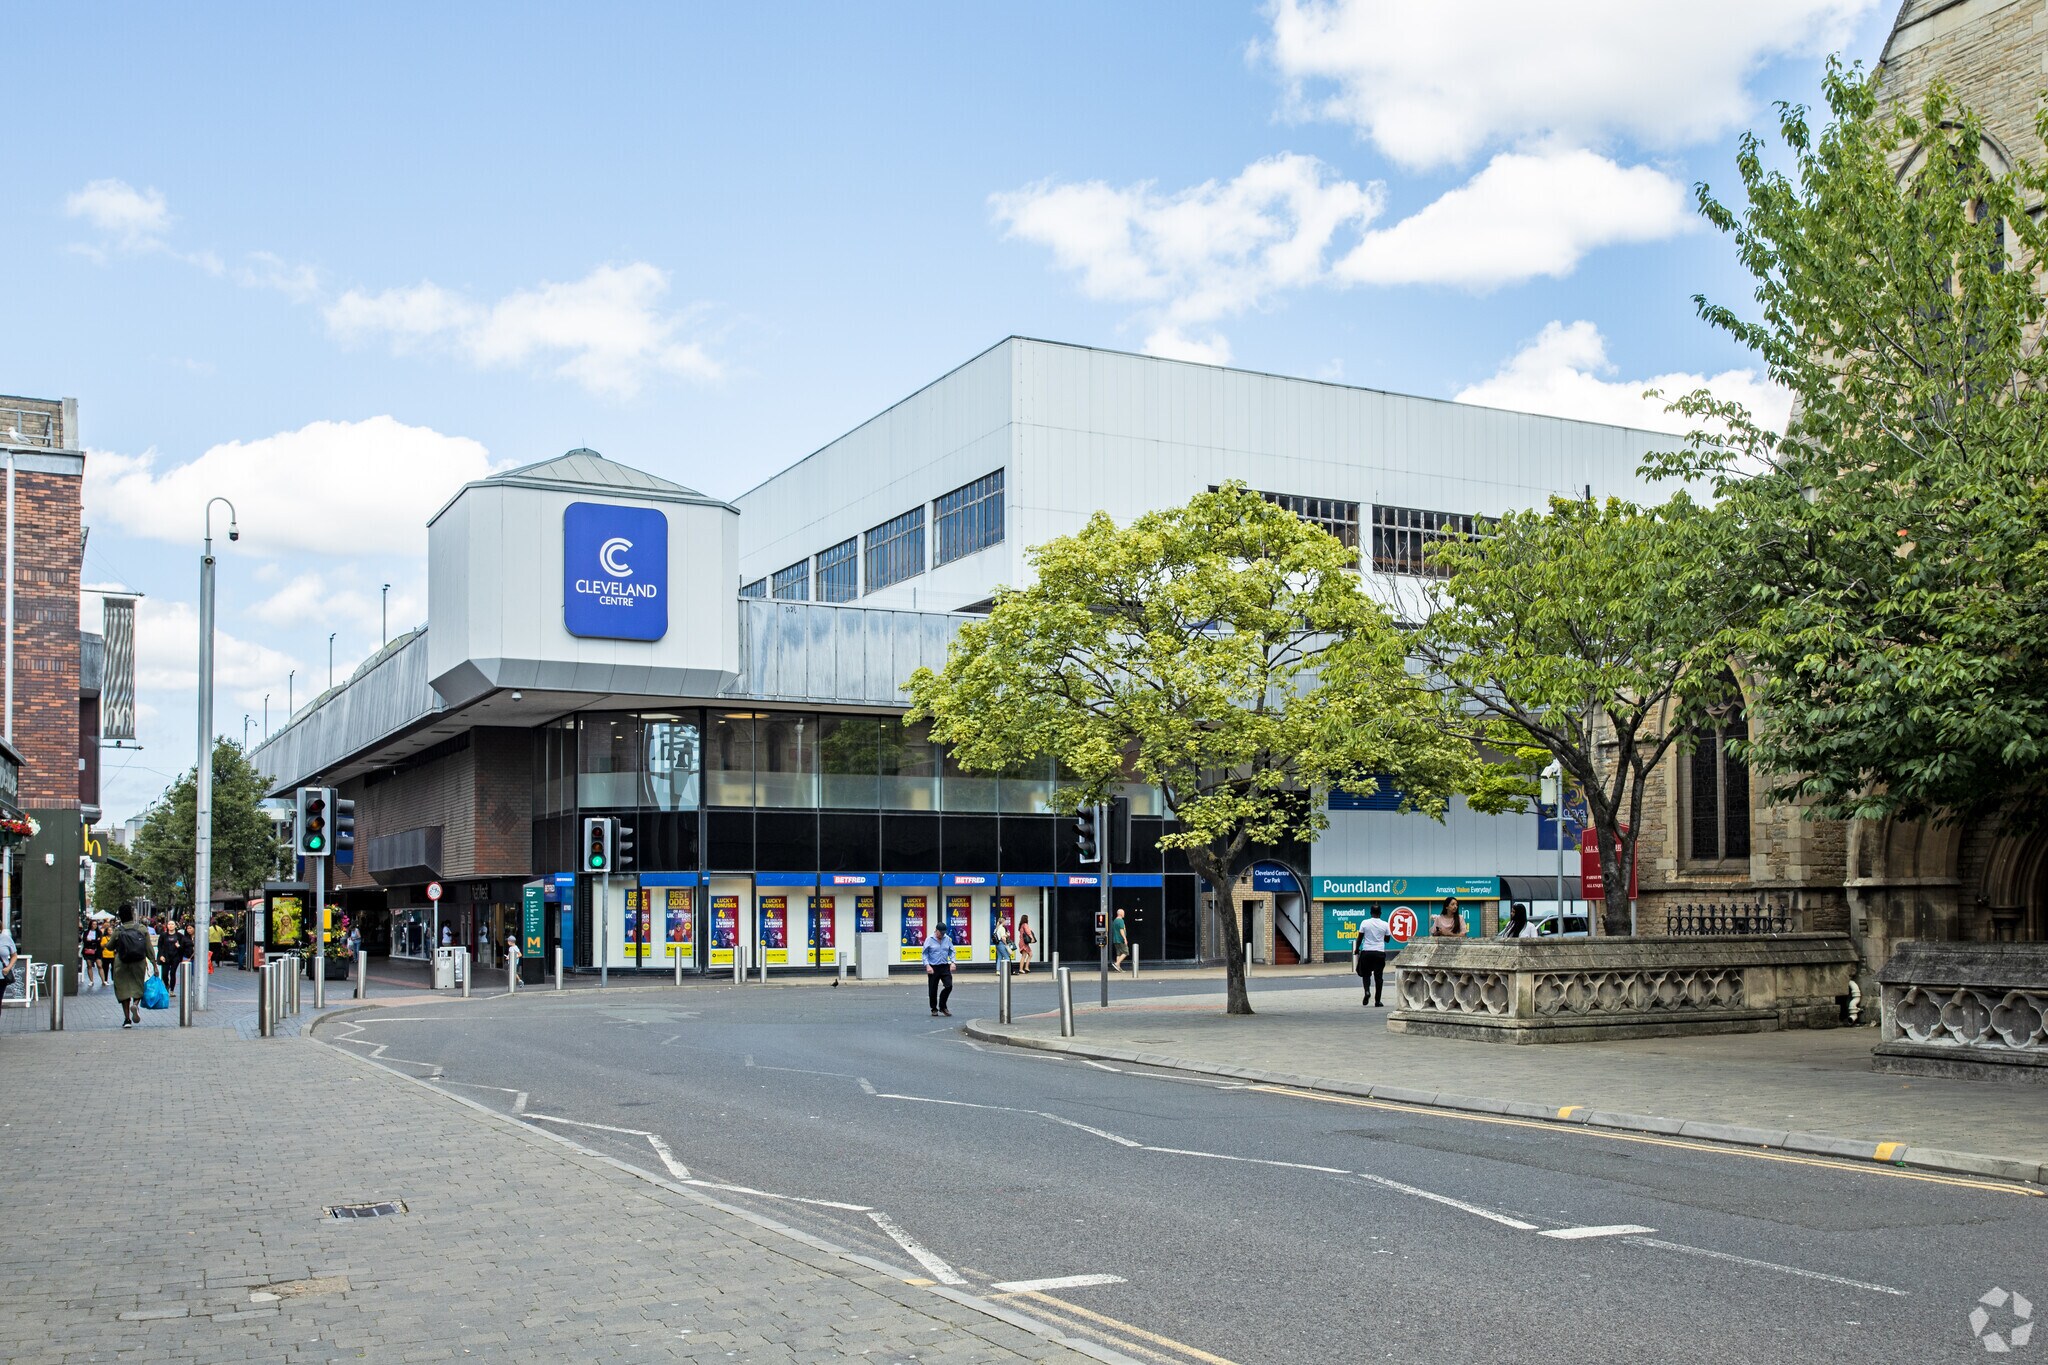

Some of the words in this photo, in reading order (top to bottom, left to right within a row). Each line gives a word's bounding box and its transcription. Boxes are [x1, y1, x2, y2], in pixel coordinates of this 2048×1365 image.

[575, 579, 657, 598] CLEVELAND
[599, 595, 634, 607] CENTRE
[834, 876, 866, 884] BETFRED
[955, 876, 985, 884] BETFRED
[1323, 879, 1391, 893] Poundland
[1435, 886, 1456, 894] Amazing
[1470, 886, 1492, 894] Everyday!
[628, 891, 647, 899] BET
[627, 899, 648, 907] ODS
[668, 898, 690, 906] ODDS
[1332, 908, 1366, 917] Poundland
[1343, 920, 1357, 932] big
[1392, 914, 1413, 937] £1
[1336, 929, 1359, 939] brand
[527, 936, 541, 948] M
